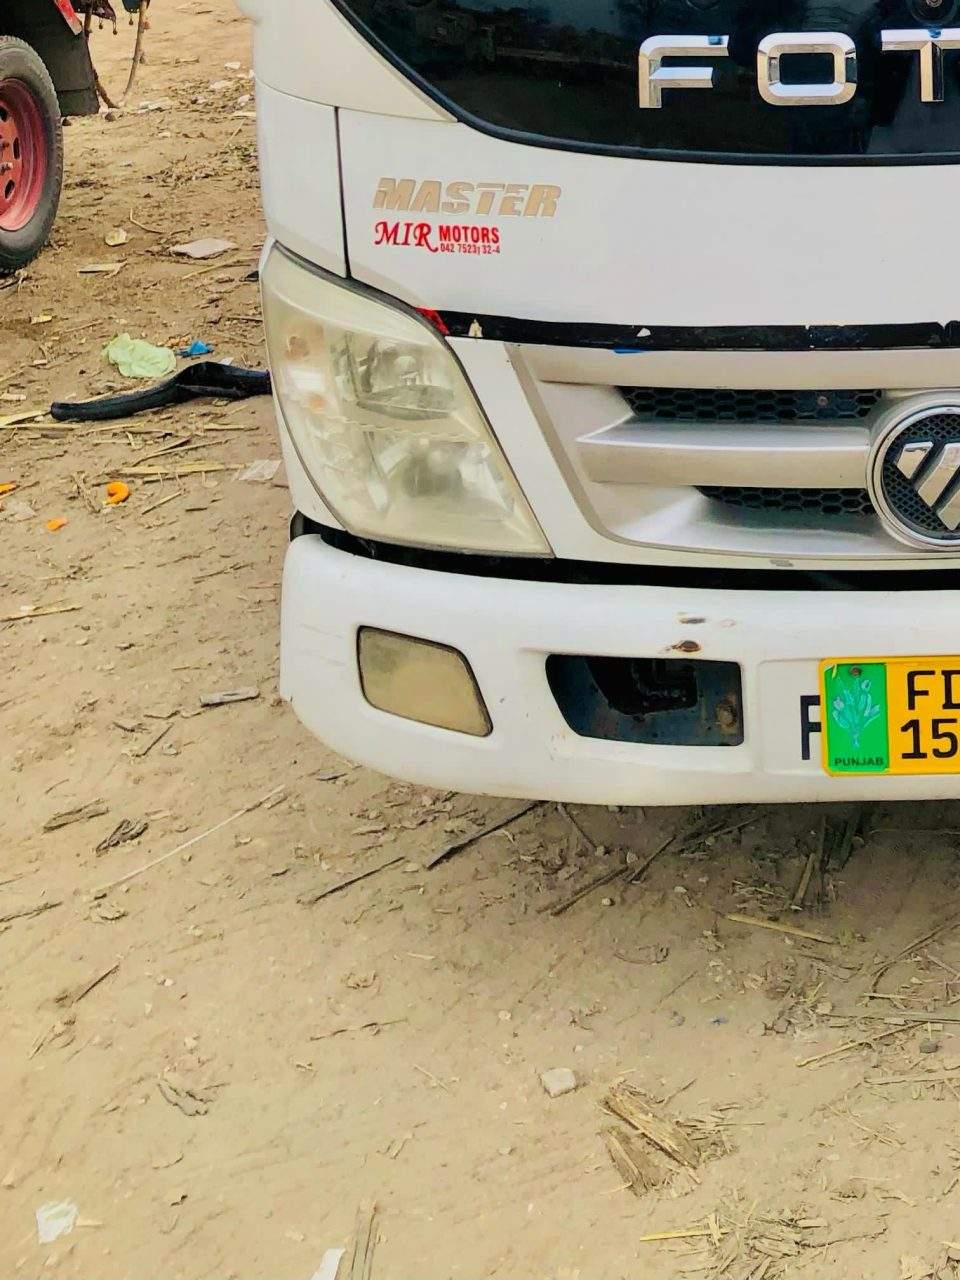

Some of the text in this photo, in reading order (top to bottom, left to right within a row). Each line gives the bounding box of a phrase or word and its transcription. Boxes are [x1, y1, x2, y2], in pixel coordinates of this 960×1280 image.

[372, 177, 563, 218] MASTER
[374, 221, 500, 253] MIR MOTORS
[833, 756, 885, 768] PUNJAB
